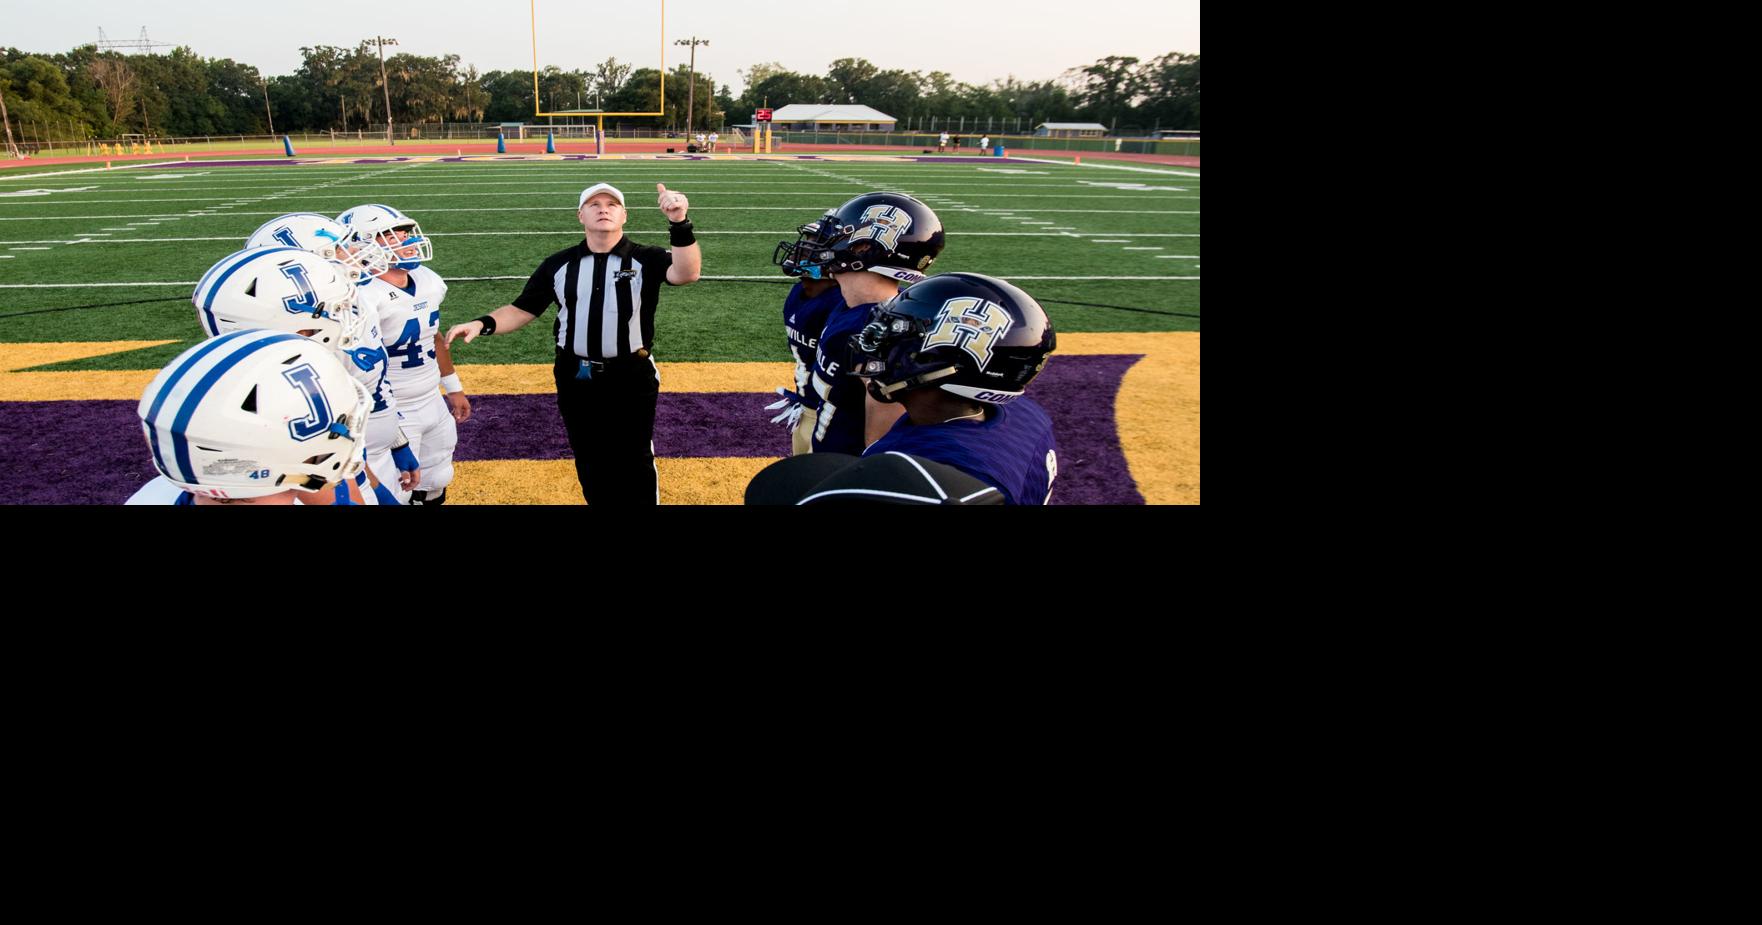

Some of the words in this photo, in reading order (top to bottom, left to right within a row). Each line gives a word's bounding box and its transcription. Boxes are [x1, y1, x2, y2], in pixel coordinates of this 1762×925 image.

[757, 110, 771, 119] 25
[279, 263, 319, 314] J
[920, 296, 1014, 373] H
[281, 363, 334, 442] J
[249, 469, 270, 479] 48
